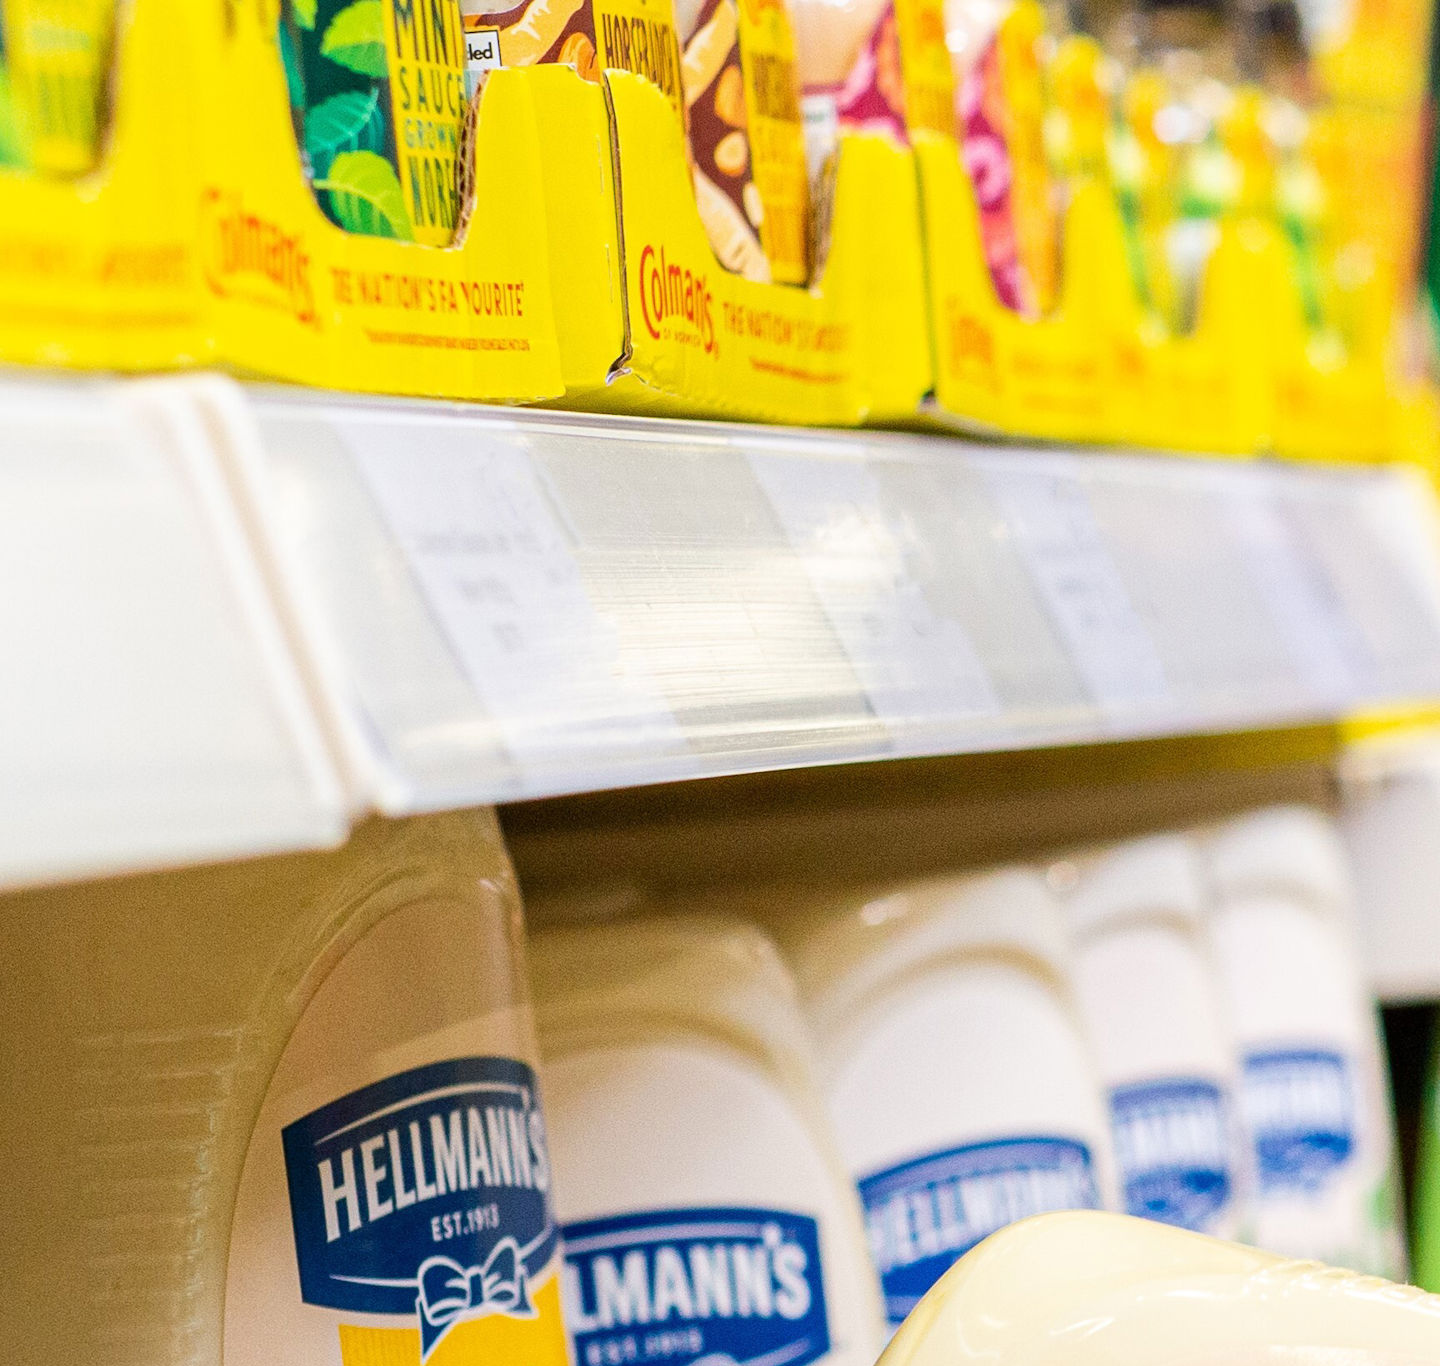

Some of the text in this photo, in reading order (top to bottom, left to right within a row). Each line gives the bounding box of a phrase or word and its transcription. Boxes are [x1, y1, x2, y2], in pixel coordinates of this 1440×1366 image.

[639, 244, 715, 353] Colman's
[317, 1091, 548, 1243] HELLMANN'S
[564, 1222, 811, 1333] LMANN'S
